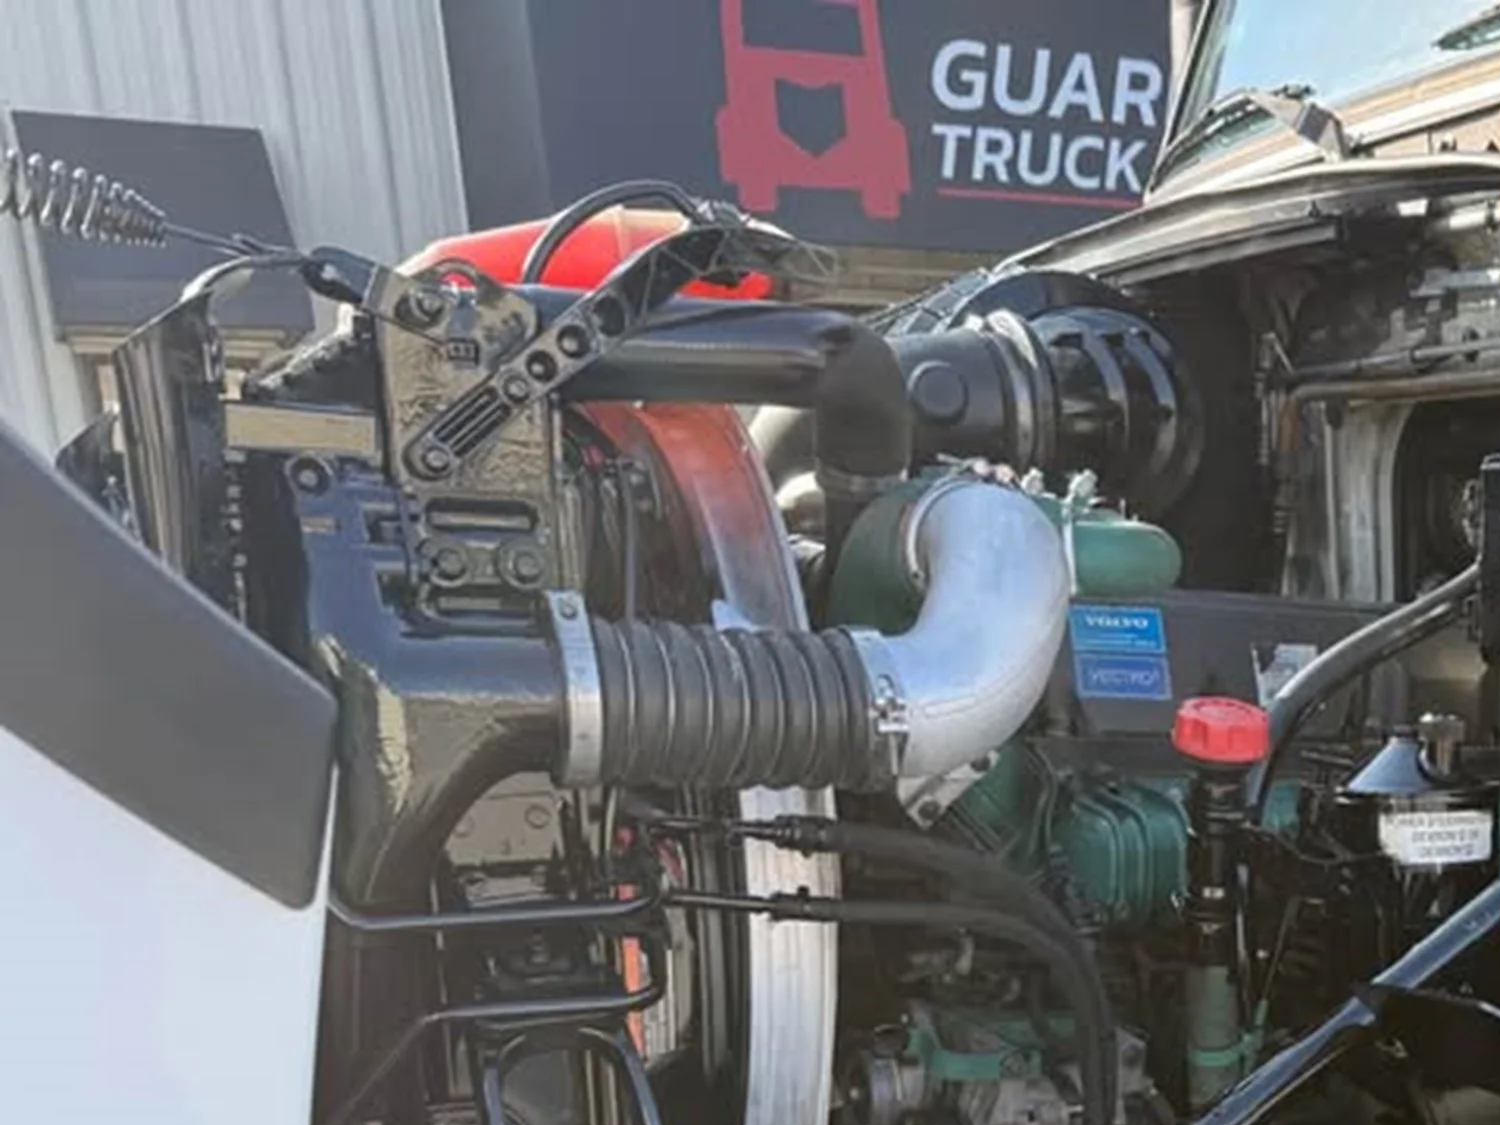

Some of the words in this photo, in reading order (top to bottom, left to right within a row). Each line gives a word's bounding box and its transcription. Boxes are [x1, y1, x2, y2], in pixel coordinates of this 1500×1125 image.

[932, 38, 1163, 127] GUAR
[932, 124, 1146, 193] TRUCK
[1086, 615, 1149, 629] VOLVO
